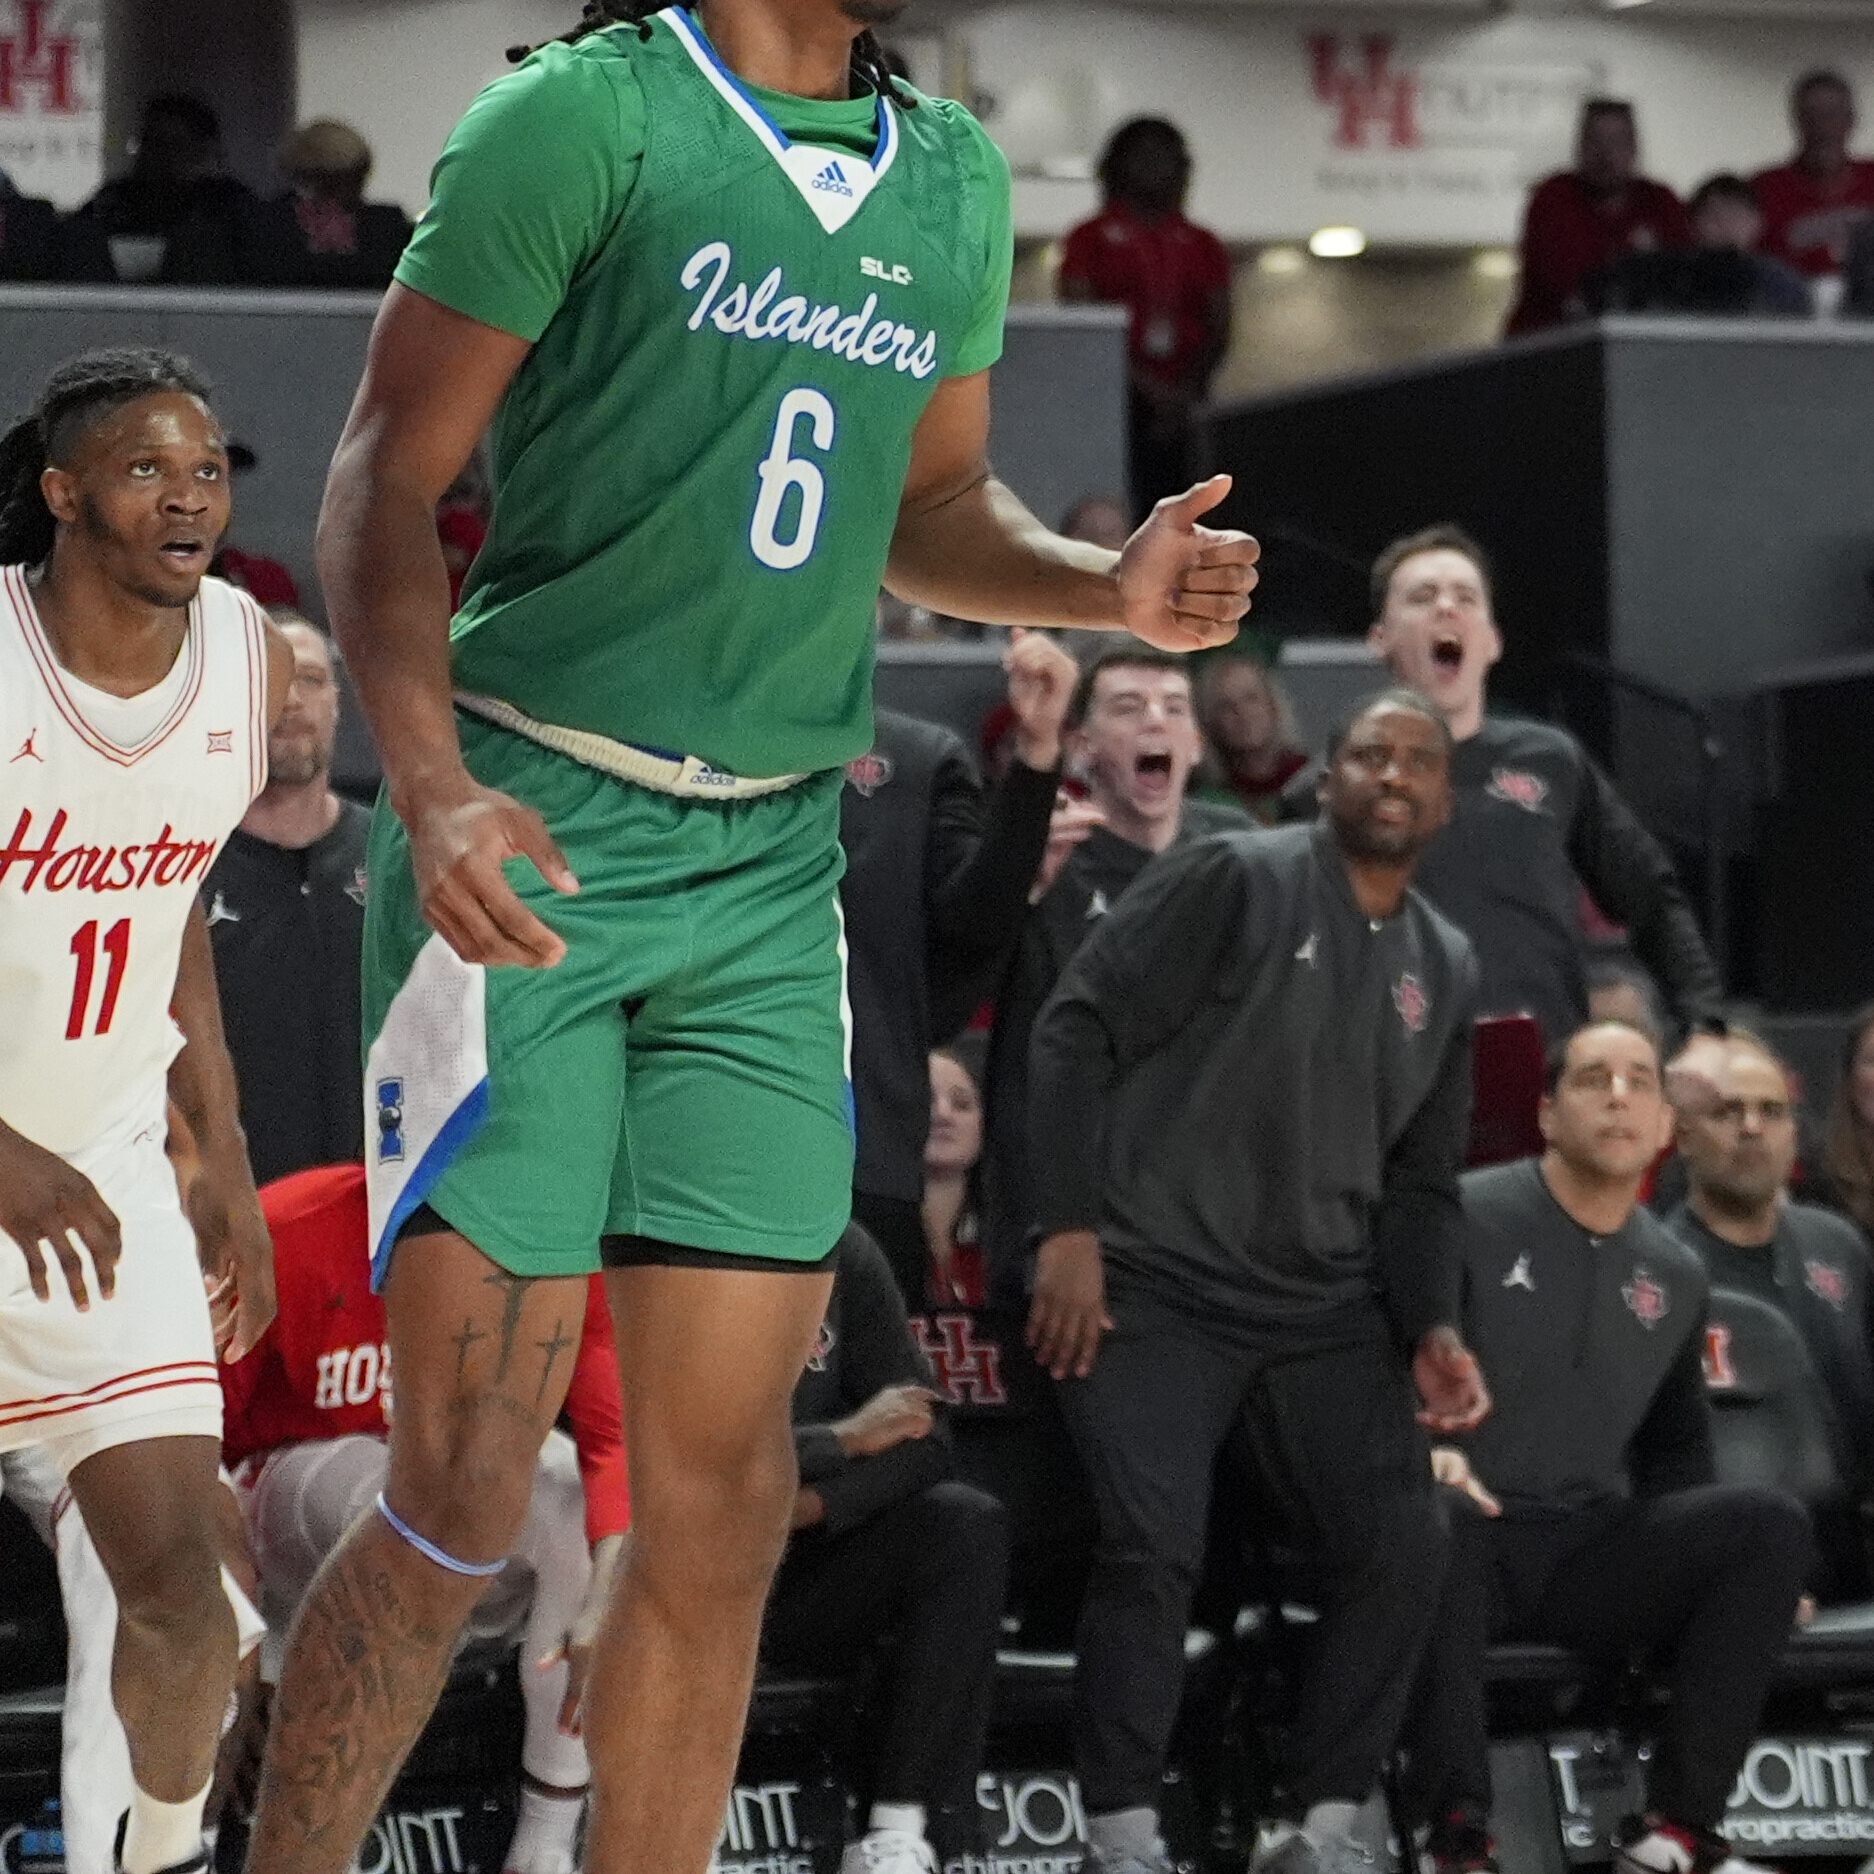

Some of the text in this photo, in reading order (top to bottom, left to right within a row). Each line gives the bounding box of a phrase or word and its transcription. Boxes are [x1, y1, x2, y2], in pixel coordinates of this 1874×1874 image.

[811, 178, 855, 199] adidas
[680, 239, 938, 379] Islanders
[860, 256, 914, 286] SLC
[748, 387, 836, 571] 6
[0, 806, 218, 895] Houston
[65, 917, 132, 1041] 11
[722, 1782, 799, 1852] INT
[997, 1778, 1089, 1847] JOI
